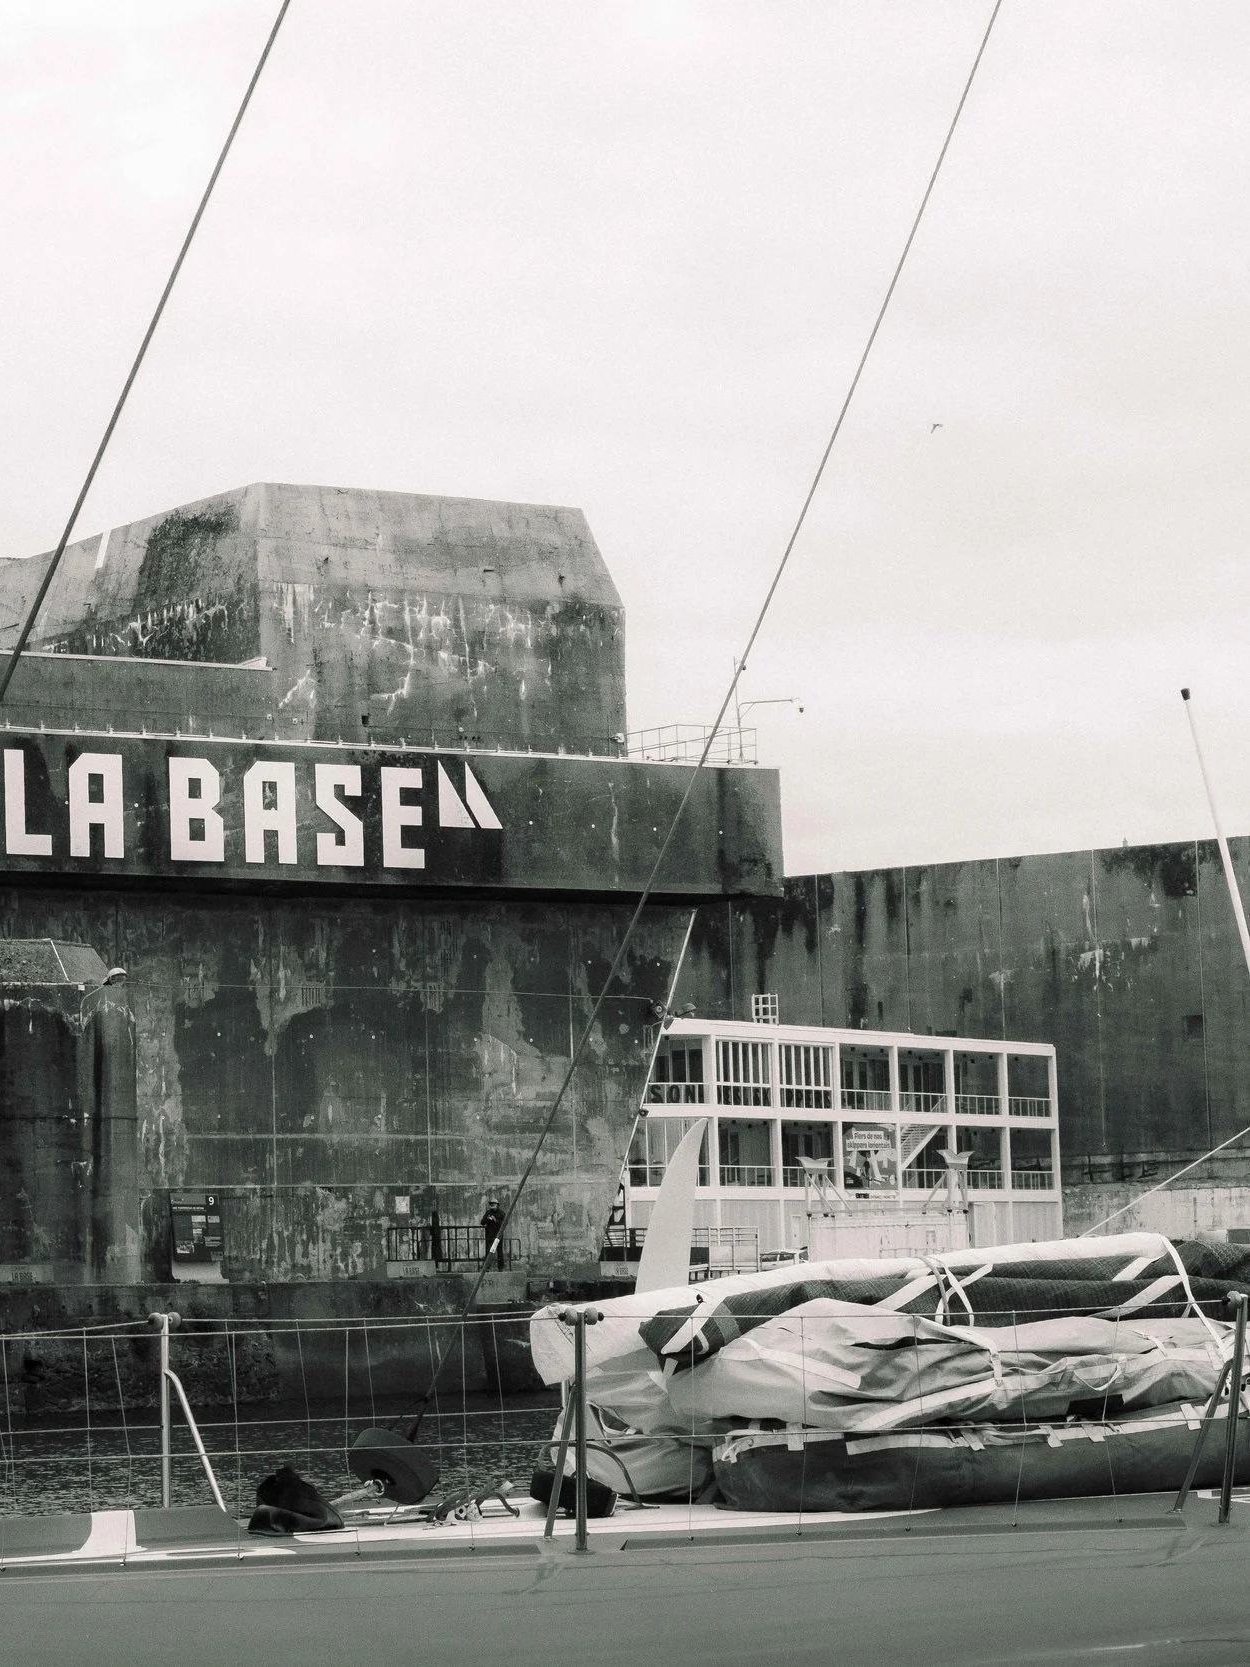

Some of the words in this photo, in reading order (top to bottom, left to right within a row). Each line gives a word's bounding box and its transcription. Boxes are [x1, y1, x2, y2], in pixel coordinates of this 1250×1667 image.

[4, 749, 124, 859] LA
[169, 757, 426, 869] BASE
[752, 1087, 832, 1109] SKPPERS
[208, 1196, 215, 1206] 9
